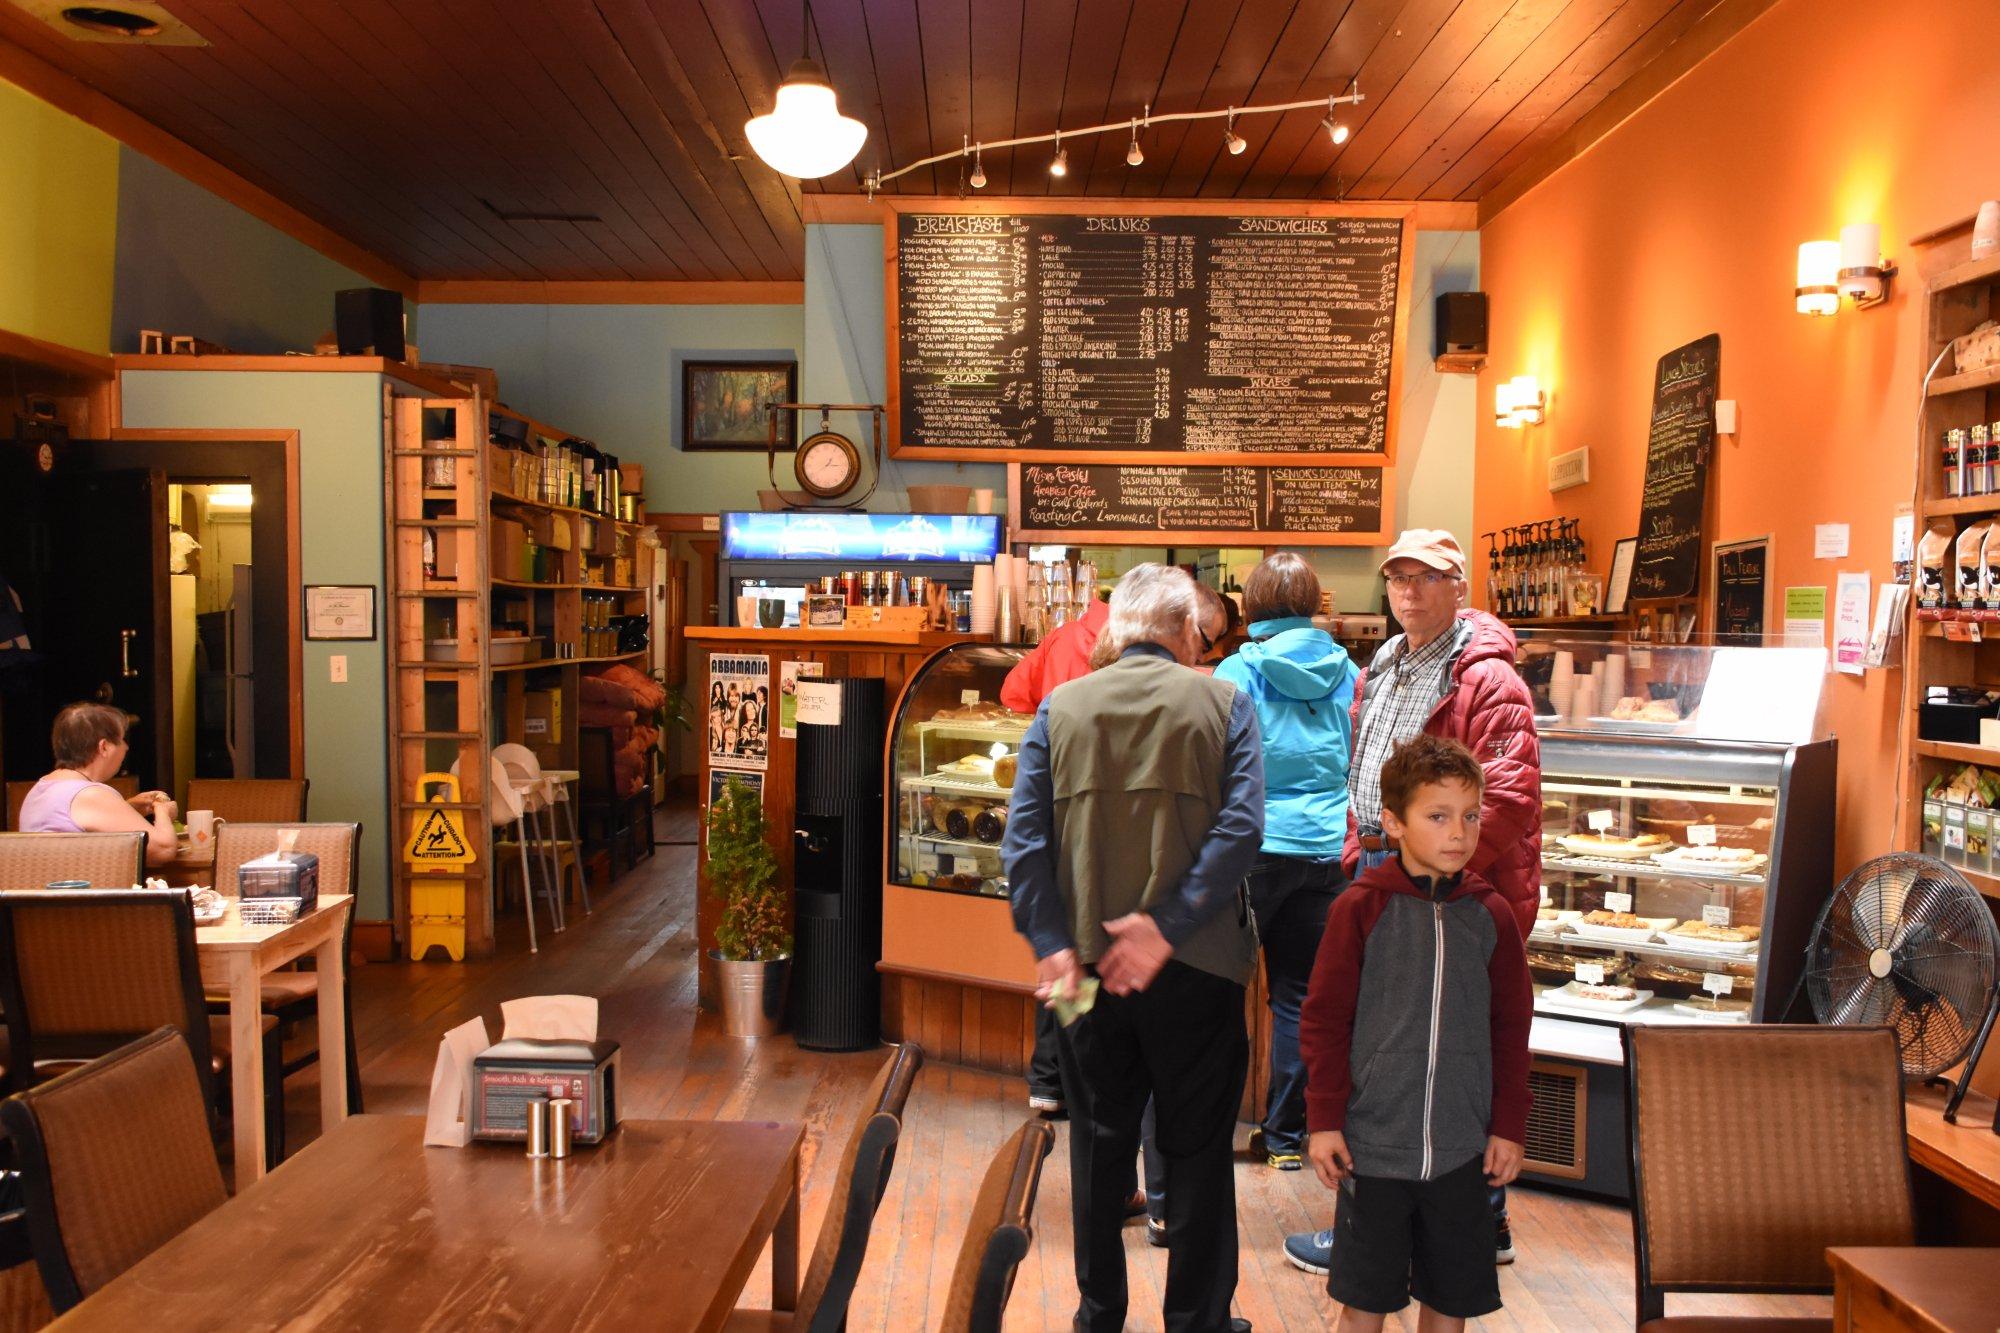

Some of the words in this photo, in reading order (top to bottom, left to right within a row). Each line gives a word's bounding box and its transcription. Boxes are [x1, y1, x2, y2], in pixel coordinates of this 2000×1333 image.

[914, 217, 1002, 233] BREAKFAST
[1086, 217, 1150, 232] DRINKS
[1239, 219, 1328, 234] SANDWICHES
[1042, 289, 1071, 297] ESPRESSO
[942, 374, 986, 383] SALADS
[1250, 377, 1291, 388] WRAPS
[1065, 418, 1095, 426] ESPRESSO
[1320, 469, 1362, 481] DISCOUNT
[1120, 476, 1162, 485] DESOLATION
[1164, 477, 1182, 486] DARK
[1298, 481, 1321, 489] MENU
[1323, 481, 1348, 489] ITEMS
[1067, 484, 1096, 498] Coffee
[1122, 487, 1147, 496] WINTER
[1149, 487, 1166, 496] COVE
[1168, 487, 1200, 497] ESPRESSO
[1052, 498, 1070, 509] Gulf
[1073, 497, 1109, 510] Islands
[1120, 496, 1152, 506] DENMAN
[1153, 496, 1172, 506] DECAF
[1029, 507, 1071, 527] Roasting
[1166, 509, 1182, 517] SAVE
[1284, 515, 1300, 523] CALL
[1311, 515, 1342, 523] ANYTIME
[1344, 515, 1354, 523] TO
[1284, 523, 1304, 531] PLACE
[1318, 523, 1341, 532] ORDER
[711, 659, 768, 675] ABBAMANIA
[415, 819, 433, 846] CAUTION
[443, 819, 461, 846] CUIDADO
[537, 1076, 570, 1087] Refreshing
